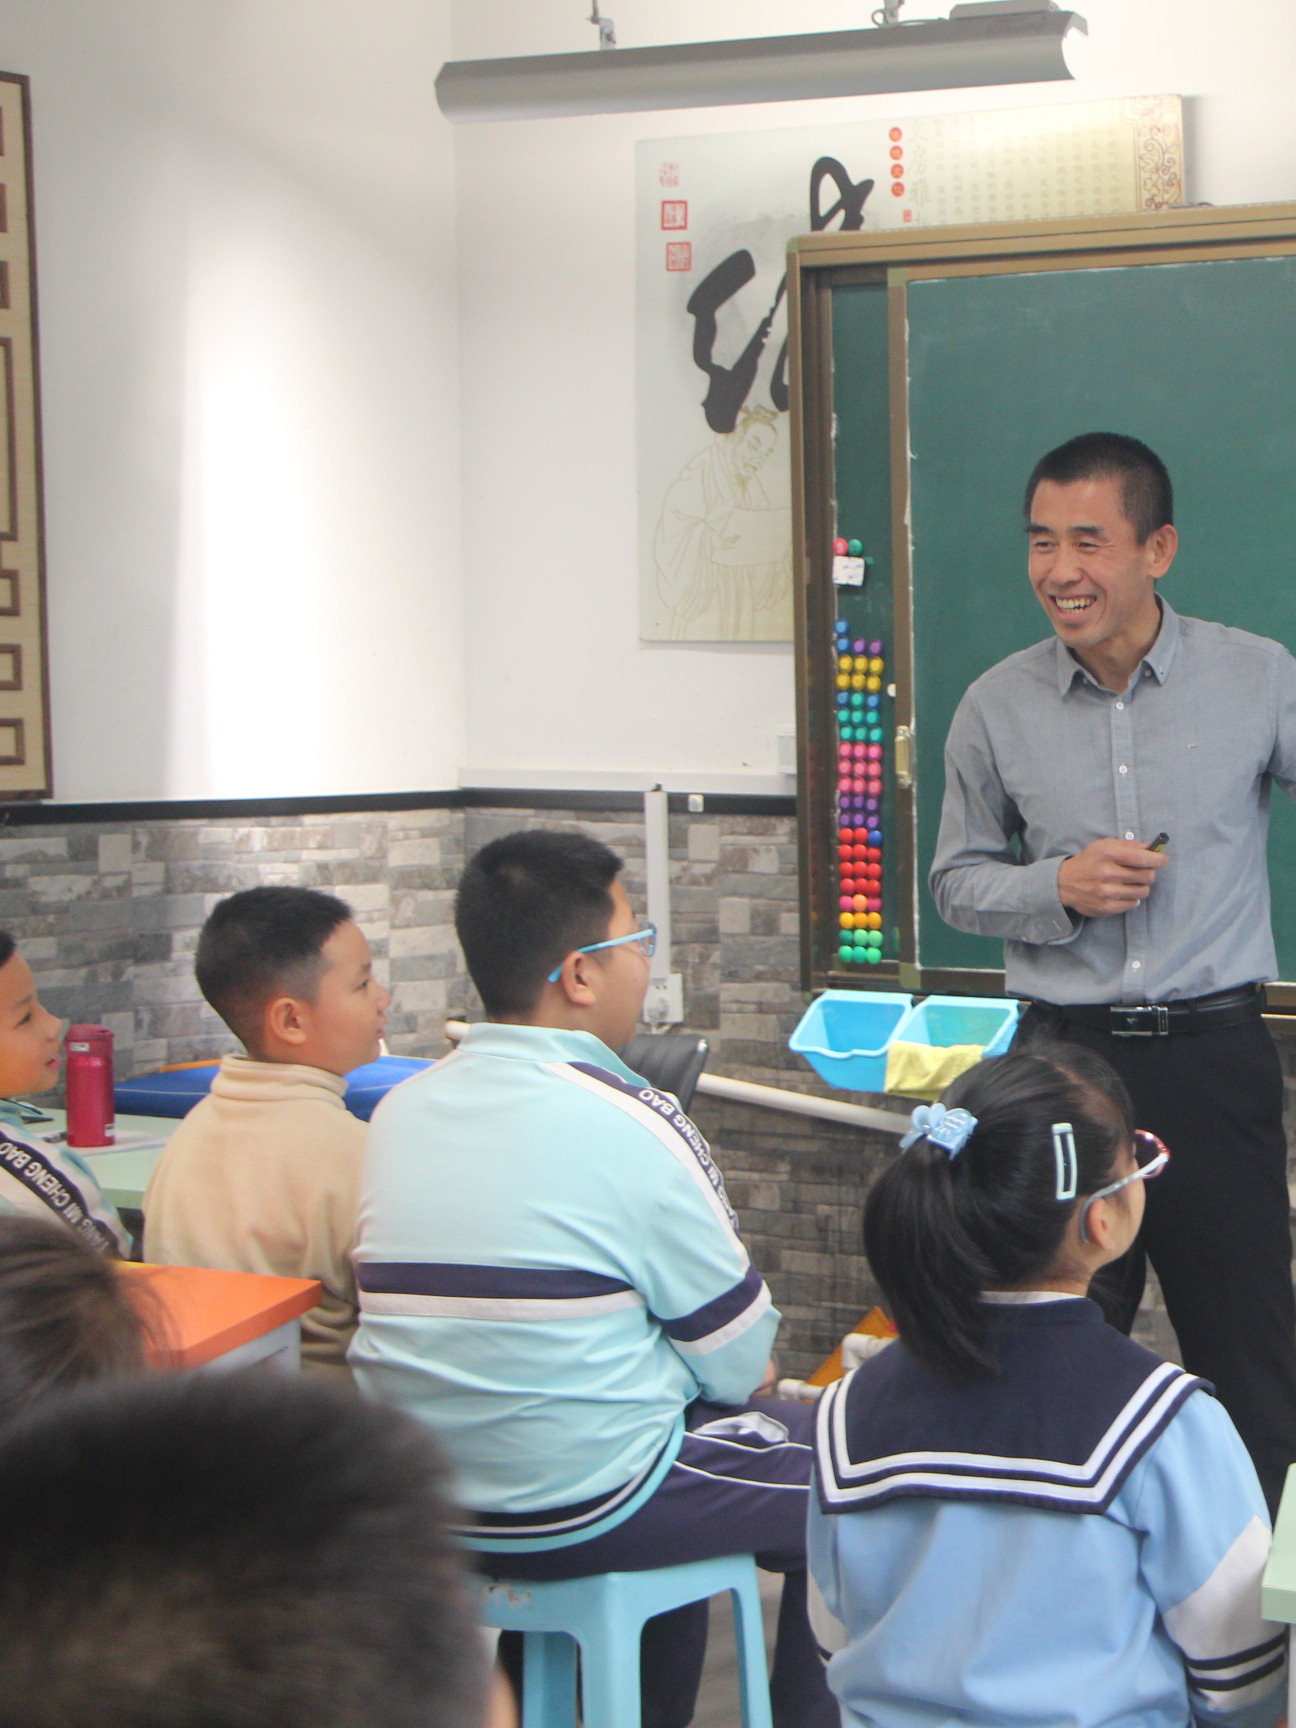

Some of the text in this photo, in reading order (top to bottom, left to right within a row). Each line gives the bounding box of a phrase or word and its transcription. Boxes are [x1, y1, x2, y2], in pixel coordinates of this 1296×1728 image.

[638, 1089, 675, 1116] BAO
[673, 1114, 710, 1166] CHENG
[0, 1142, 31, 1169] BAO
[23, 1161, 71, 1207] CHENG
[62, 1202, 83, 1225] MI
